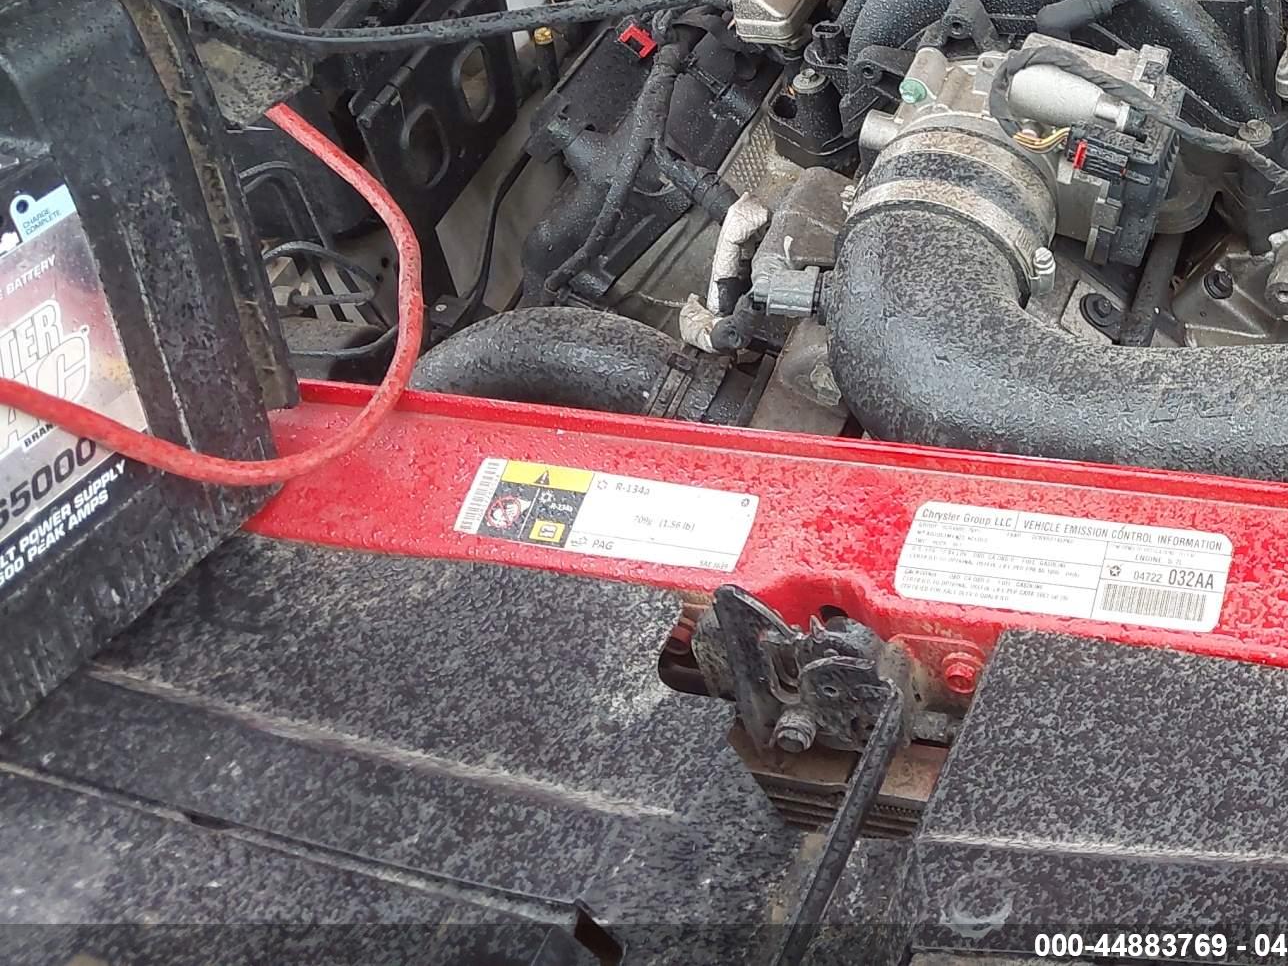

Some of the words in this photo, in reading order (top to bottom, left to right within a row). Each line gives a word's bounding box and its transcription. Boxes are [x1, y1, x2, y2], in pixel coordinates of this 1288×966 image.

[23, 208, 50, 229] CHARGE
[25, 209, 61, 235] COMPLETE
[6, 254, 55, 295] BATTERY
[24, 424, 55, 448] BRAN
[19, 504, 71, 552] POWER
[73, 459, 126, 508] SUPPLY
[27, 524, 66, 562] PEAK
[68, 489, 109, 530] AMPS
[922, 508, 960, 521] Chrysler
[963, 513, 991, 526] Group
[994, 517, 1012, 527] LLC
[1023, 520, 1061, 534] VEHICLE
[1063, 523, 1108, 538] EMISSION
[1111, 529, 1153, 544] CONTROL
[1157, 536, 1222, 552] INFORMATION
[592, 539, 614, 550] PAG
[1133, 571, 1163, 583] 04722
[1168, 569, 1214, 590] 032AA
